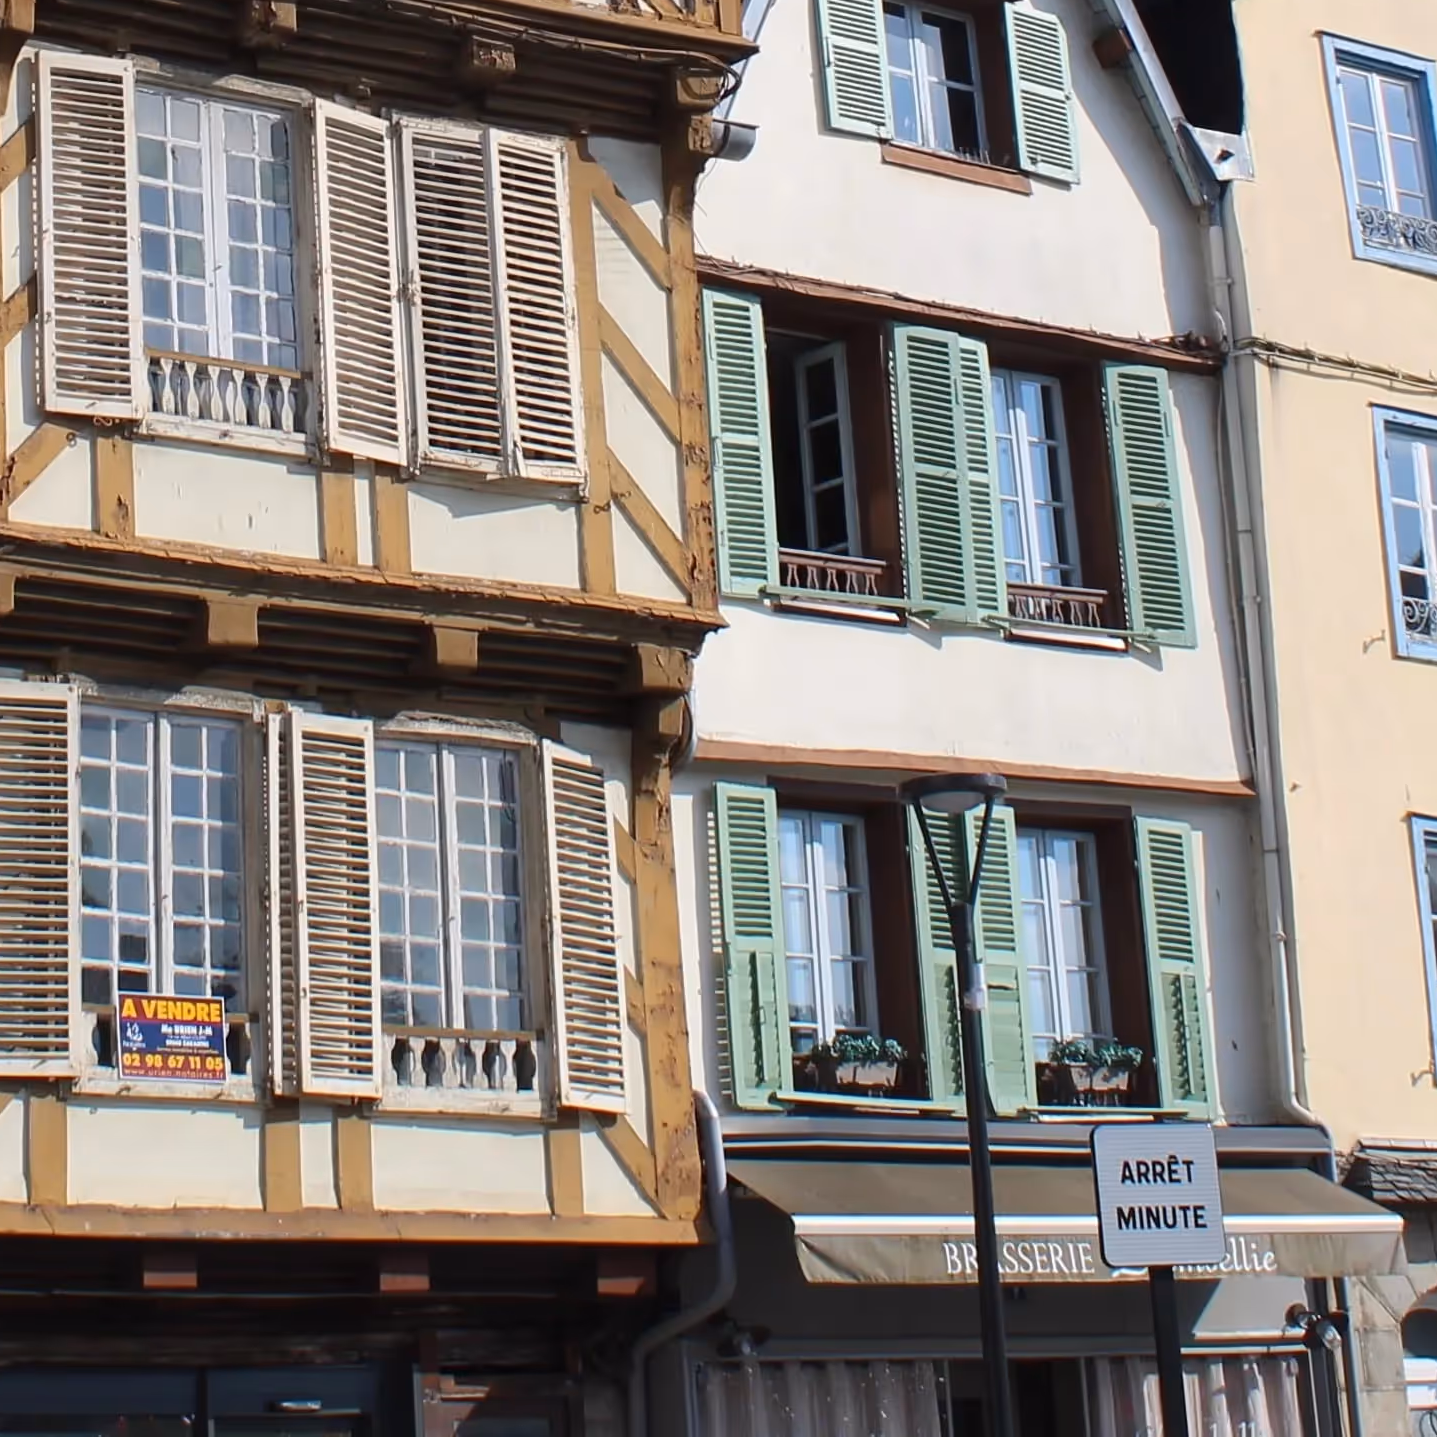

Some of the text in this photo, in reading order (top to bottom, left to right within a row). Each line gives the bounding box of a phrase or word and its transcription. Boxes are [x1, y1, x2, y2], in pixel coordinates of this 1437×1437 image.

[122, 998, 221, 1022] A VENDRE
[123, 1053, 223, 1071] 02 98 67 11 05
[1121, 1155, 1195, 1184] ARRÊT
[1116, 1205, 1208, 1231] MINUTE
[943, 1242, 1096, 1275] BRSSERIE
